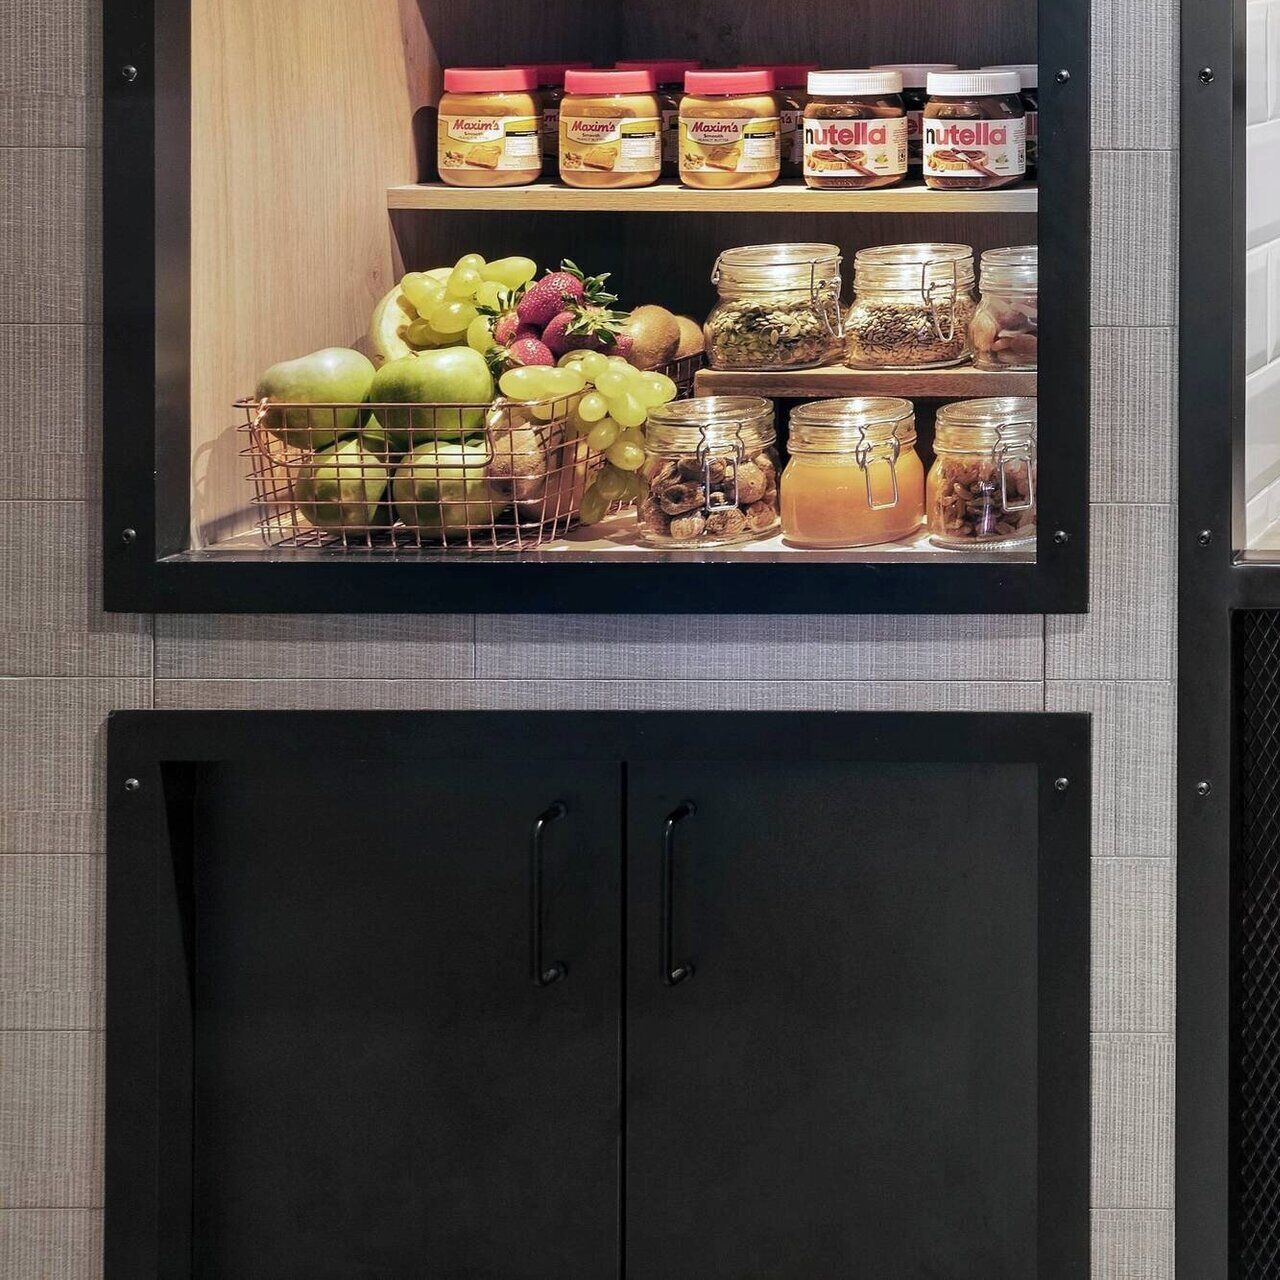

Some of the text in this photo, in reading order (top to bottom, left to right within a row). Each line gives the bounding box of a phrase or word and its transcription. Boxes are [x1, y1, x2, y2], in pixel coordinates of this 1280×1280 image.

[453, 119, 500, 130] Maxim's
[572, 121, 616, 132] Maxim's
[692, 122, 739, 133] Maxim's
[806, 122, 886, 145] nutella
[926, 122, 1007, 145] nutella
